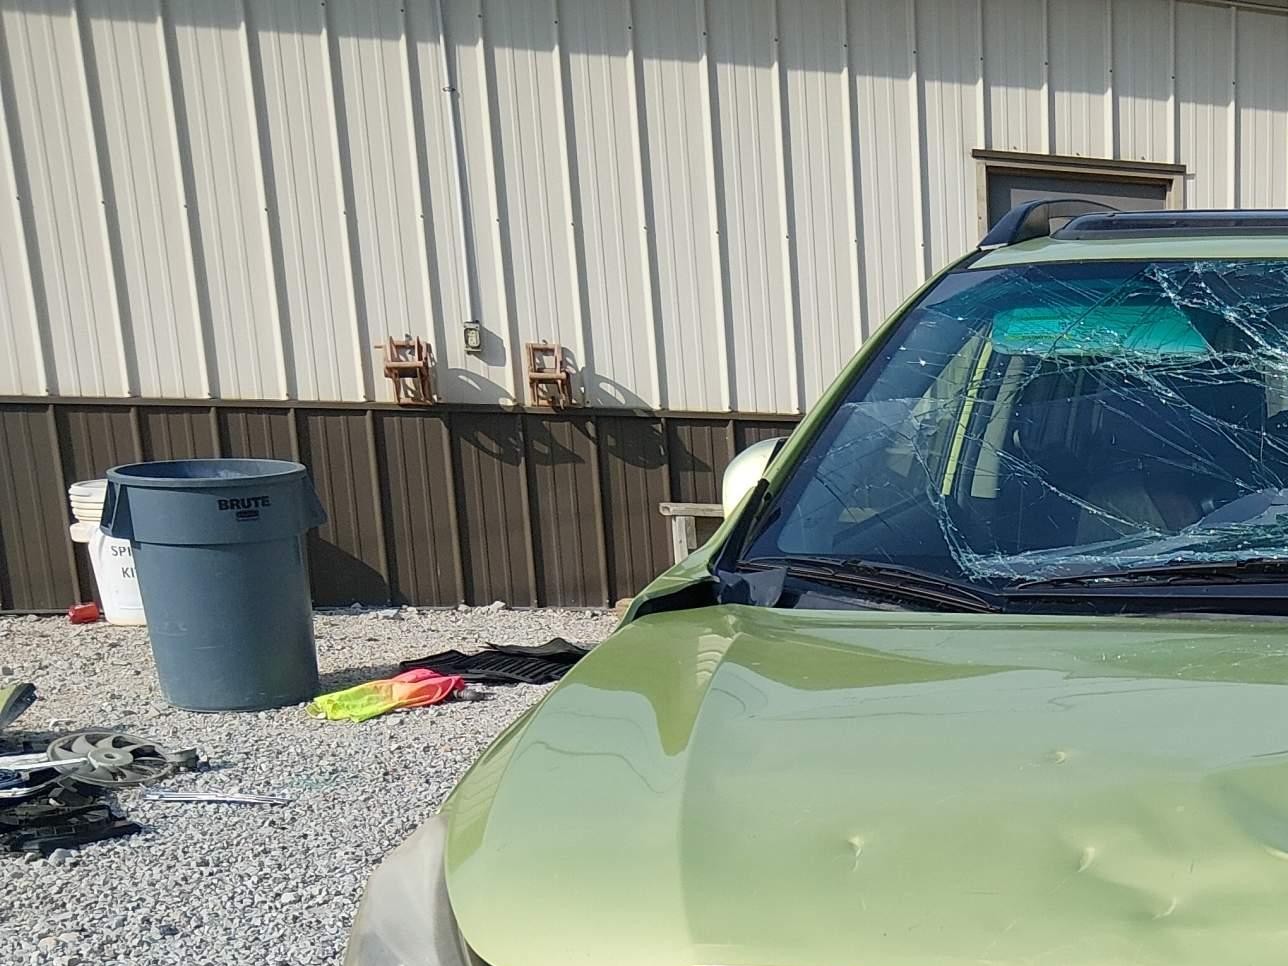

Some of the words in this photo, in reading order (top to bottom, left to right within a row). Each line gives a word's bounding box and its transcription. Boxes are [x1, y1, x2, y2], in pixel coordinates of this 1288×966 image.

[217, 495, 271, 511] BRUTE
[111, 545, 132, 557] SPI
[121, 567, 136, 578] KI
